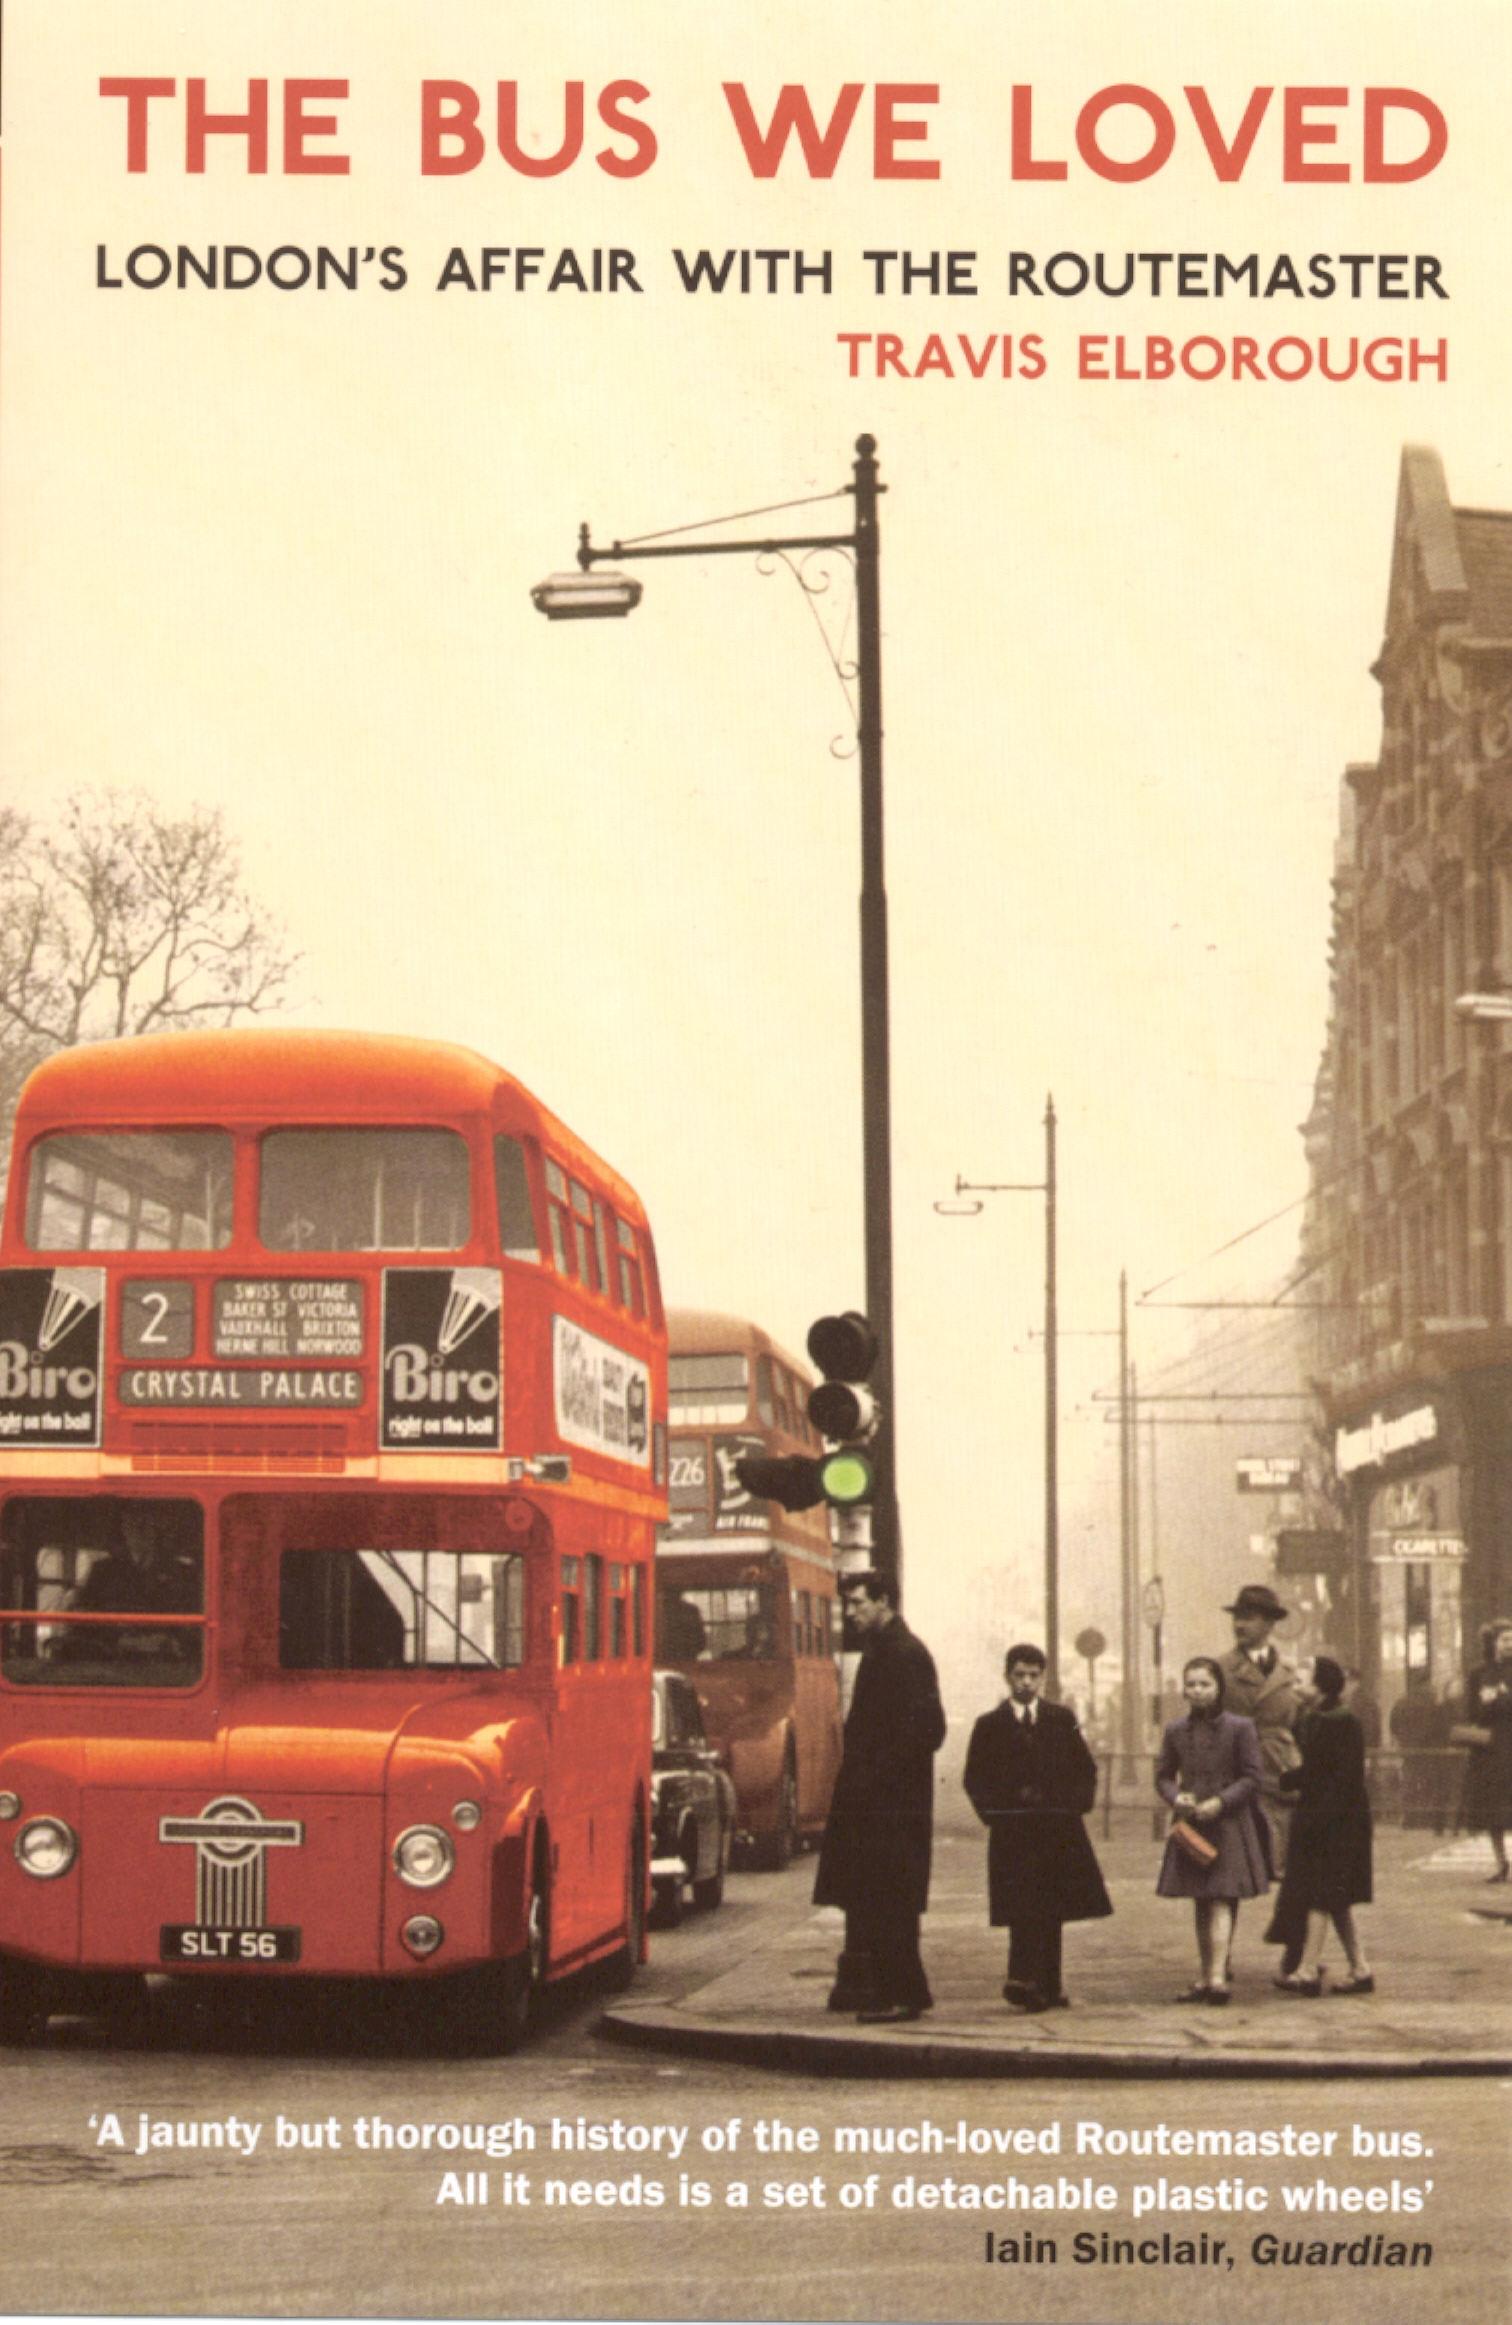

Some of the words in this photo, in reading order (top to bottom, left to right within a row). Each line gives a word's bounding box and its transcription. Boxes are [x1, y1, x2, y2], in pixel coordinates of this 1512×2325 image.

[234, 1283, 281, 1300] SWISS
[289, 1283, 348, 1300] COTTAGE
[140, 1292, 169, 1343] 2
[222, 1301, 267, 1318] BAKER
[272, 1301, 287, 1318] ST
[297, 1302, 357, 1318] VICTORIA
[219, 1320, 288, 1336] VAUXHALL
[303, 1320, 361, 1336] BRIXTON
[216, 1338, 258, 1355] HERNE
[261, 1338, 289, 1355] HILL
[297, 1338, 363, 1355] NORWOOD
[0, 1341, 96, 1399] Biro
[385, 1344, 499, 1402] Biro
[131, 1370, 242, 1399] CRYSTAL
[260, 1370, 358, 1399] PALACE
[24, 1415, 40, 1430] on
[42, 1411, 62, 1430] the
[63, 1411, 91, 1430] ball
[388, 1415, 422, 1438] right
[424, 1419, 441, 1434] on
[443, 1416, 463, 1435] the
[466, 1415, 494, 1435] ball
[670, 1457, 705, 1487] 226
[181, 1931, 233, 1955] SLT
[239, 1932, 277, 1957] 56
